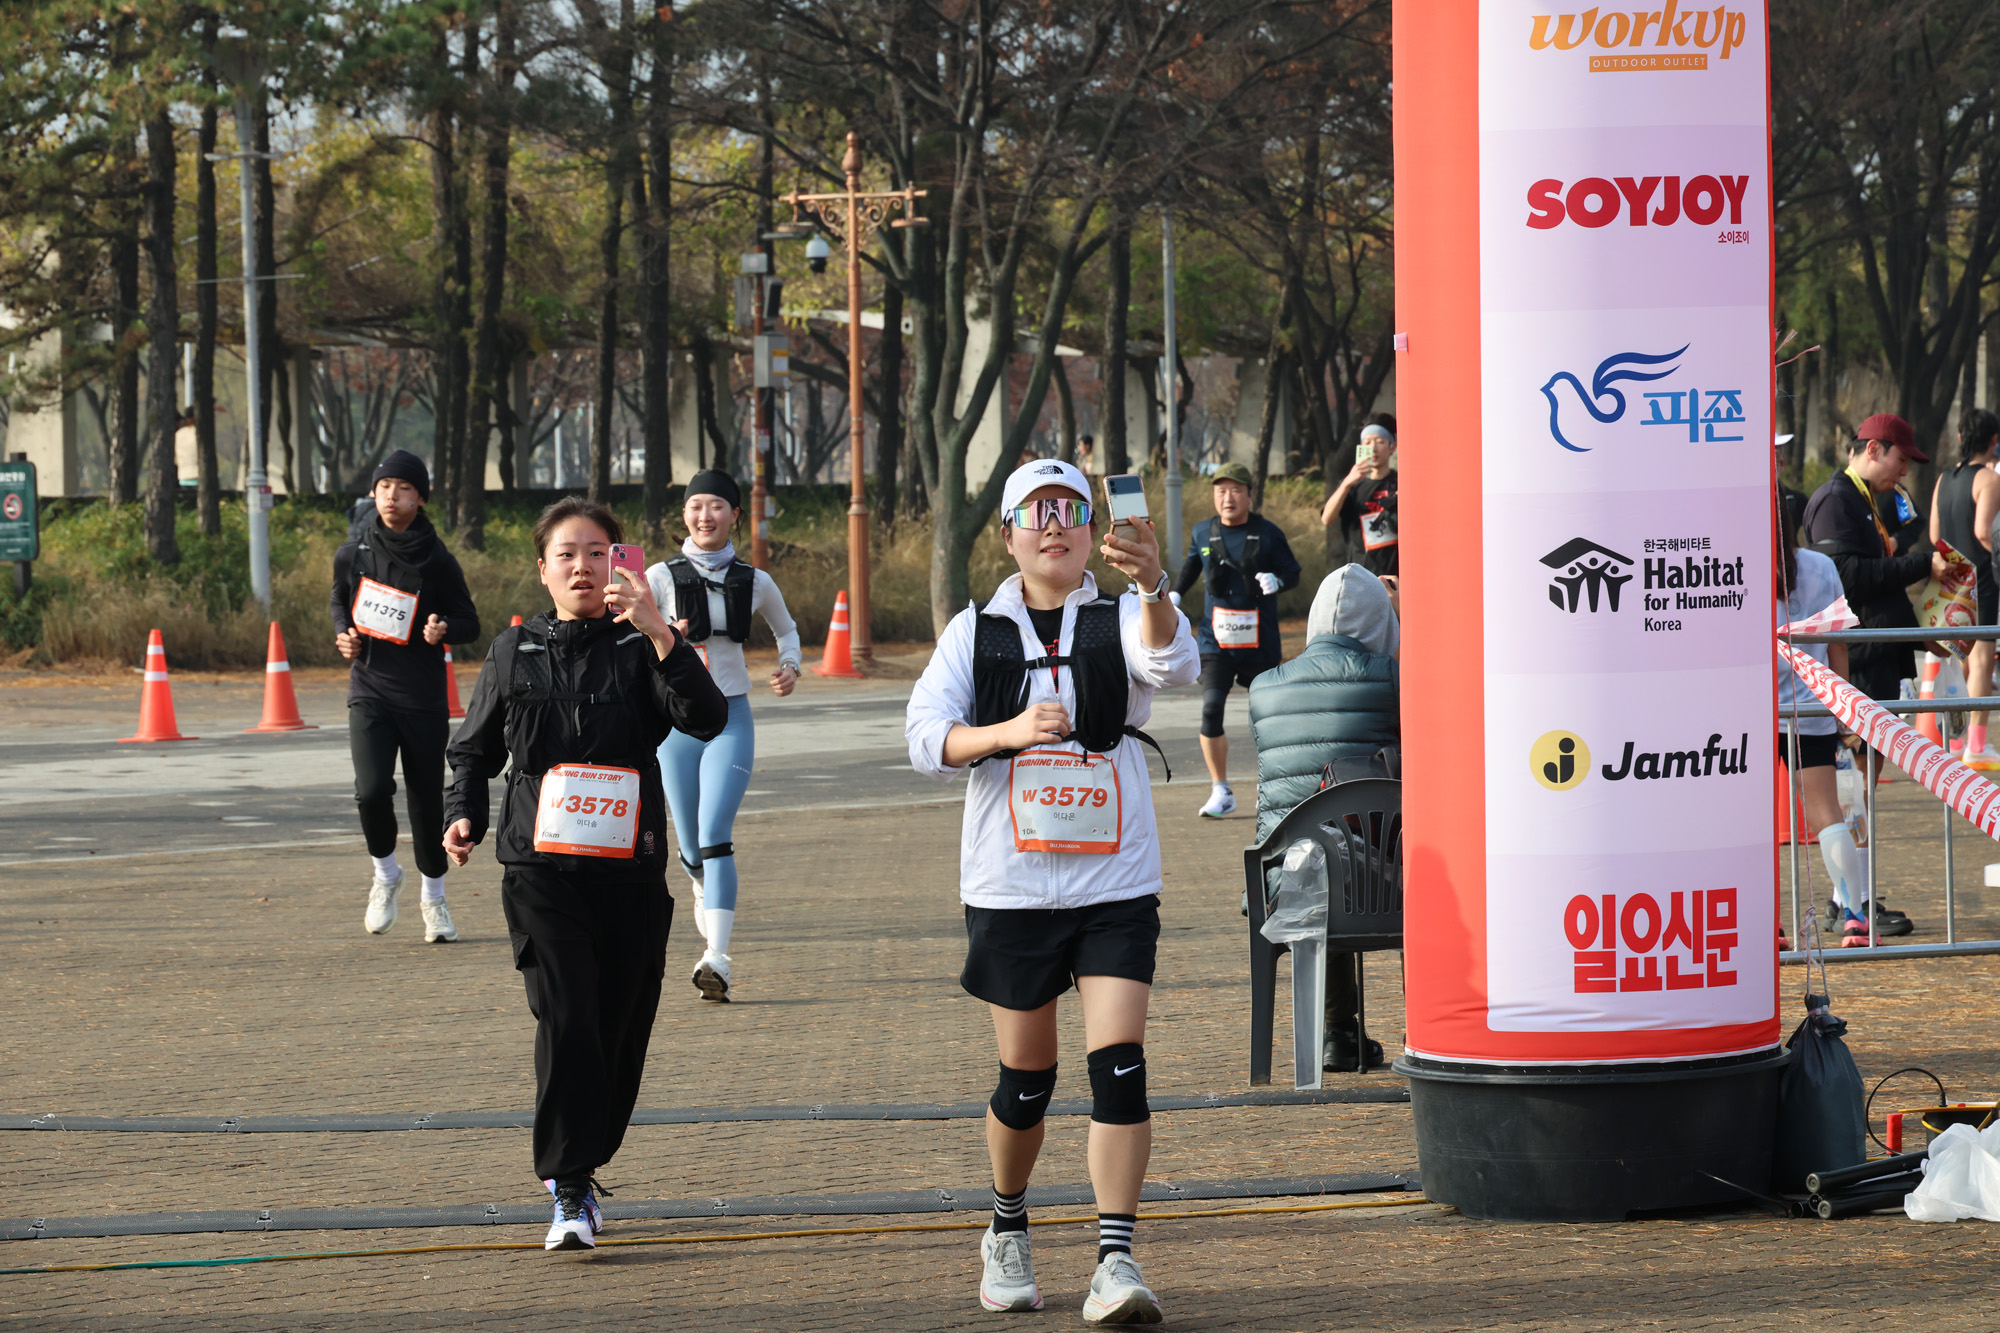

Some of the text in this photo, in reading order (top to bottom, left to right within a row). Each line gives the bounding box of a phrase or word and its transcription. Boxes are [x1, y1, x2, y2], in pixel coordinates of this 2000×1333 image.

[1592, 57, 1706, 69] OUTDOOR OUTLET
[1526, 174, 1750, 230] SOYJOY
[1718, 230, 1750, 244] 소이조이
[1640, 388, 1746, 443] 피죤
[1643, 537, 1712, 553] 한국해비타트
[1644, 555, 1744, 589] Habitat
[1644, 593, 1670, 611] for
[1644, 617, 1682, 631] Korea
[1017, 759, 1052, 767] BURNING
[1053, 759, 1073, 767] RUN
[1602, 733, 1748, 781] Jamful
[580, 771, 598, 780] RUN
[597, 773, 624, 782] STORY
[1053, 812, 1076, 821] 이다은
[1563, 887, 1738, 993] 일요신문
